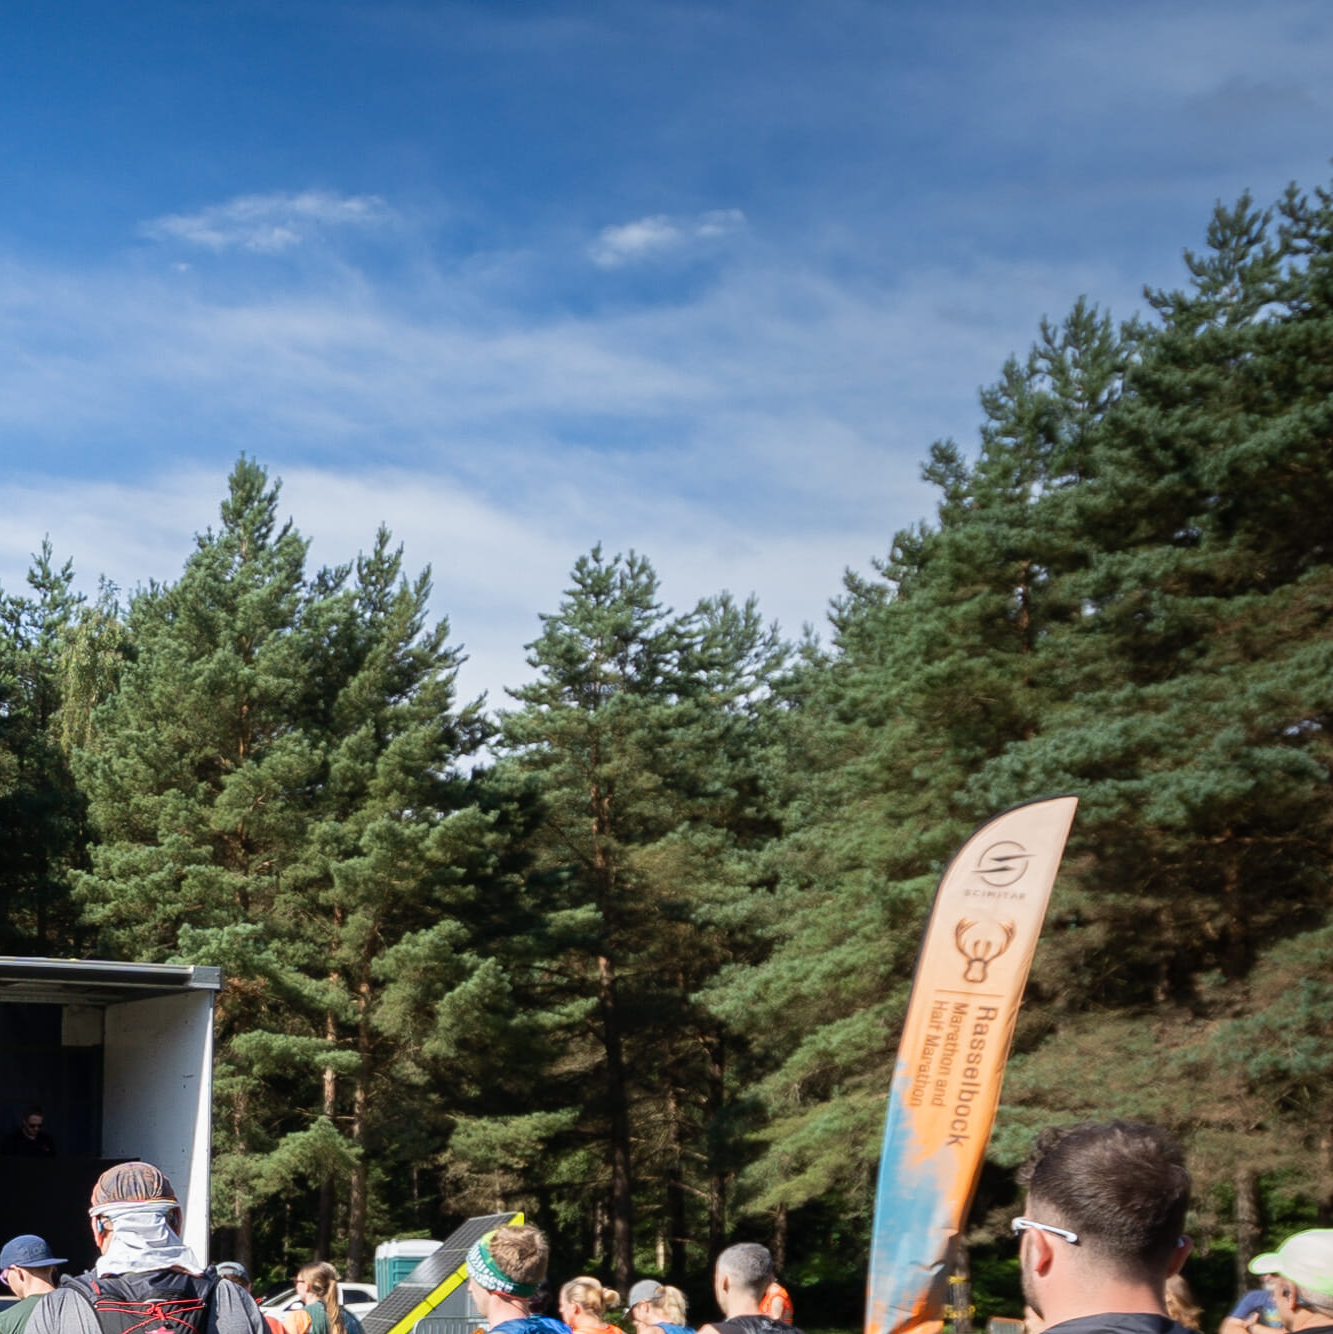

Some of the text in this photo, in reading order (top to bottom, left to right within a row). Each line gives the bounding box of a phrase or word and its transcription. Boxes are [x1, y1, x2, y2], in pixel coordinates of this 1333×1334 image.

[909, 1000, 950, 1107] Half Marathon
[931, 1002, 970, 1107] Marathon and
[946, 1006, 999, 1147] Rasselbock
